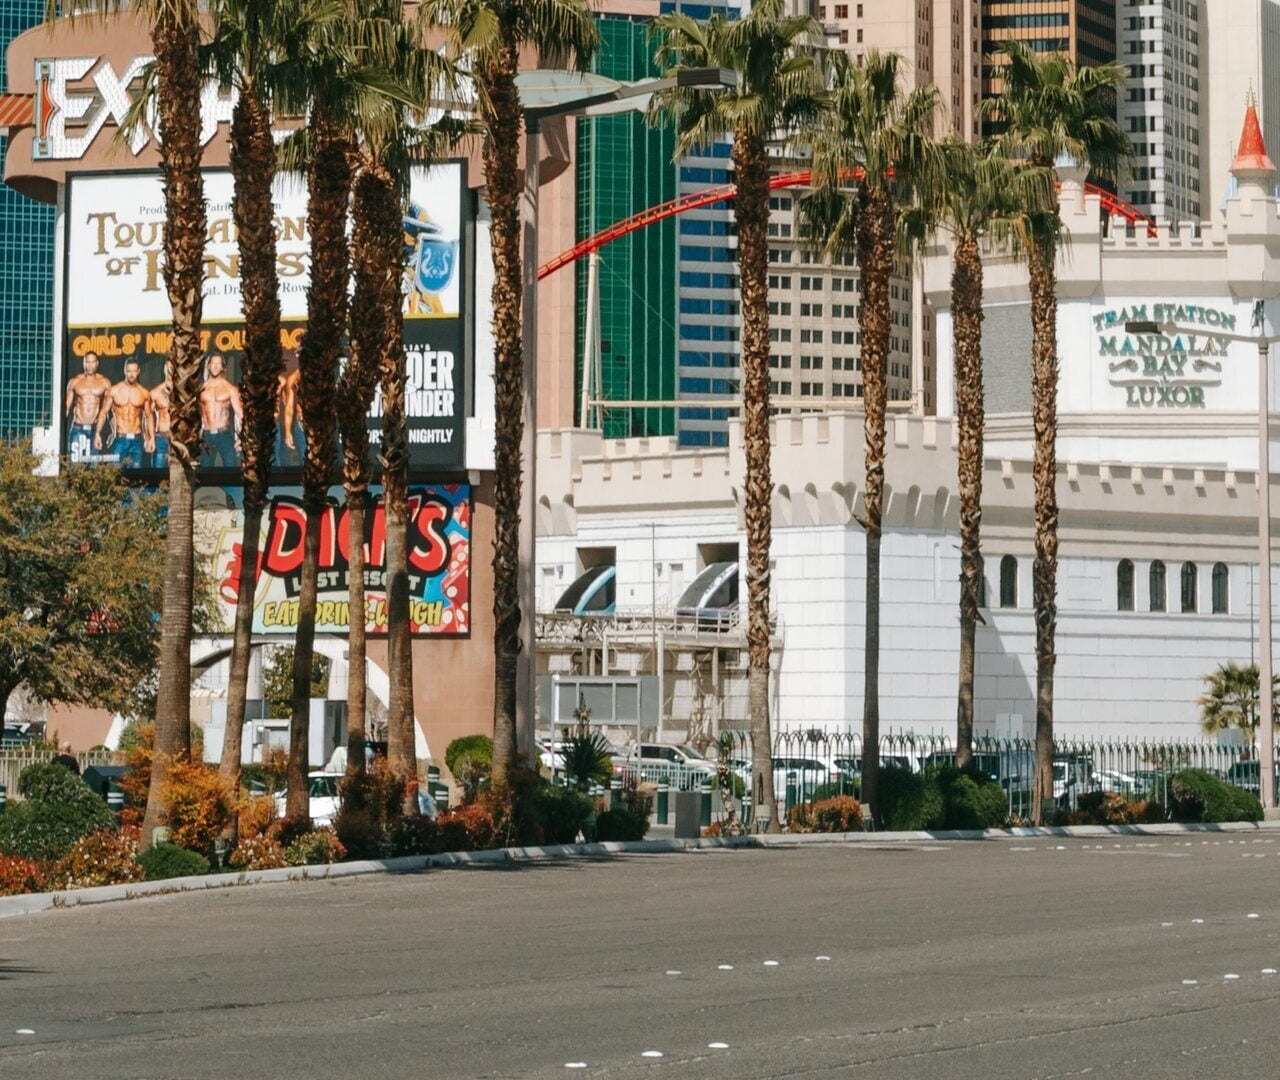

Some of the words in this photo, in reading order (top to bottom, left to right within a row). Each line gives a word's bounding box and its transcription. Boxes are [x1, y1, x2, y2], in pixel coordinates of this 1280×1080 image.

[1153, 303, 1237, 331] STATION
[72, 333, 141, 357] GIRLS'
[1099, 335, 1232, 356] MANDALAY
[1143, 355, 1188, 376] BAY
[1126, 385, 1206, 408] LUXOR
[408, 428, 454, 443] NIGHTLY
[293, 571, 340, 593] LST
[263, 600, 301, 627] EAT
